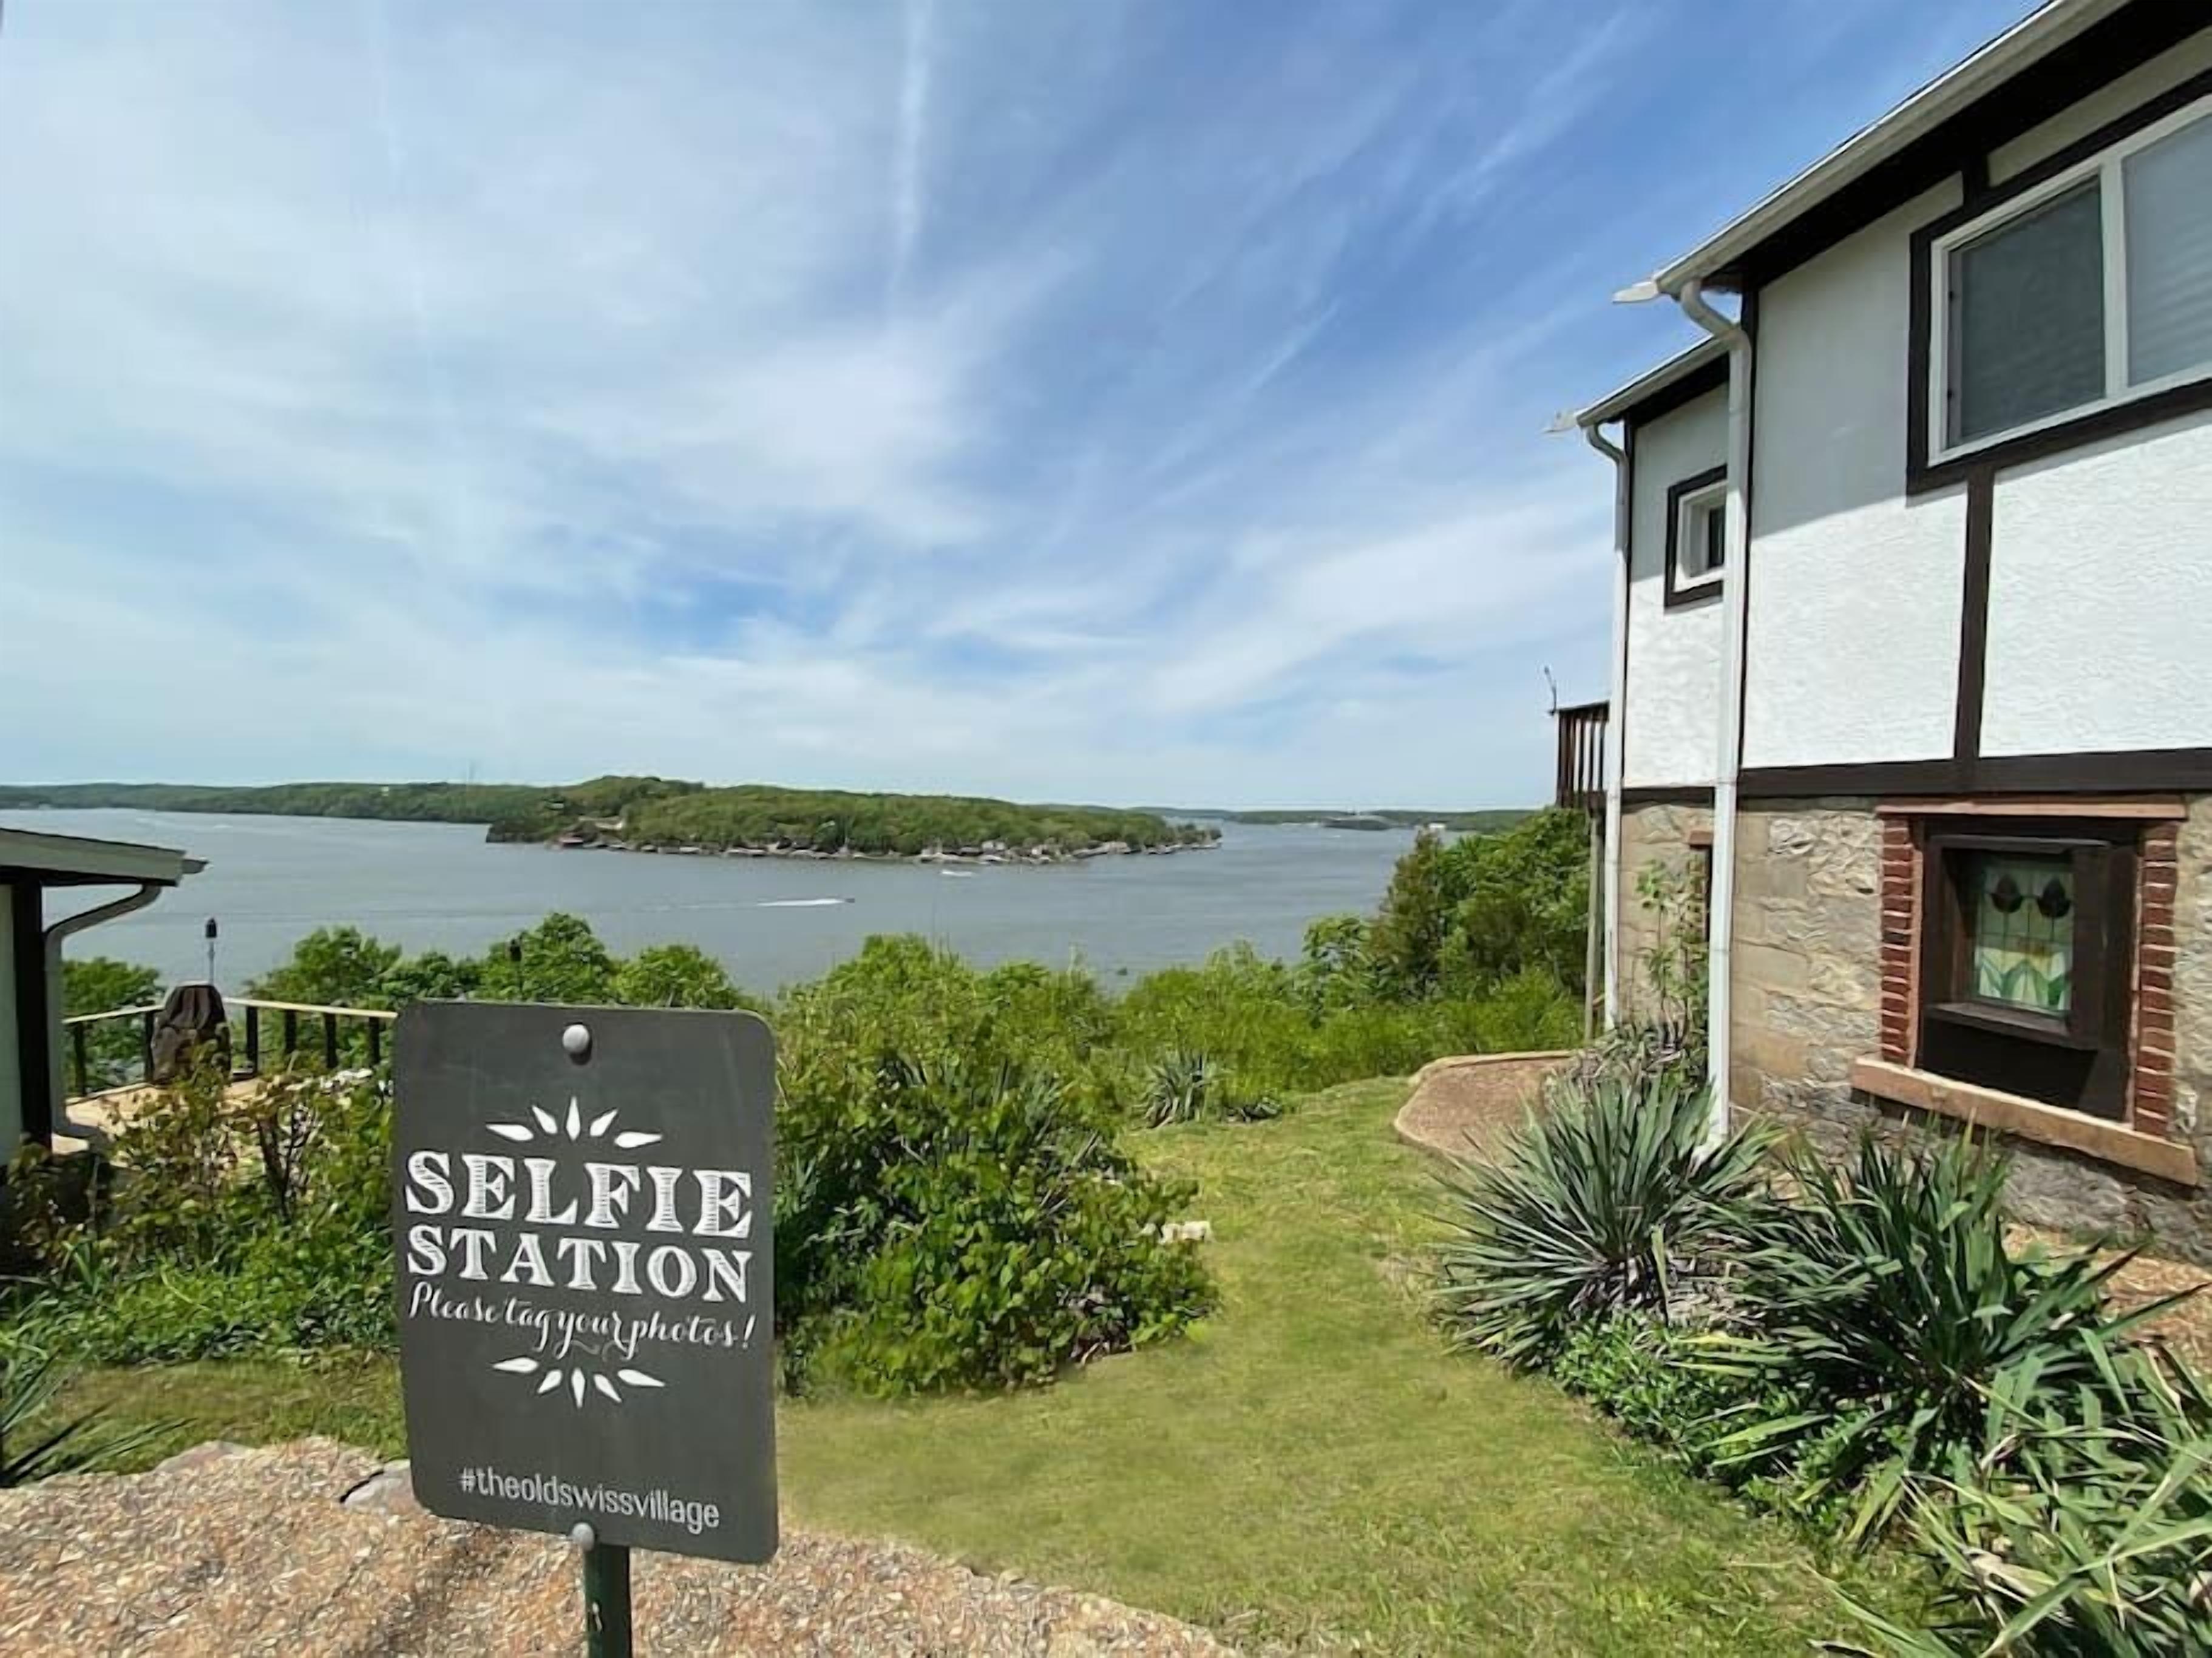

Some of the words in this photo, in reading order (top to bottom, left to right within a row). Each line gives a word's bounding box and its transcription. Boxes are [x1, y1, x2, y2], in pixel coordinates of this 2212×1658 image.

[405, 1151, 751, 1239] SELFIE
[407, 1224, 753, 1303] STATION
[409, 1281, 500, 1324] Please
[503, 1296, 551, 1352] tag
[556, 1310, 625, 1359] your
[624, 1310, 756, 1360] photos!
[460, 1466, 720, 1535] #theoldswissvillage
